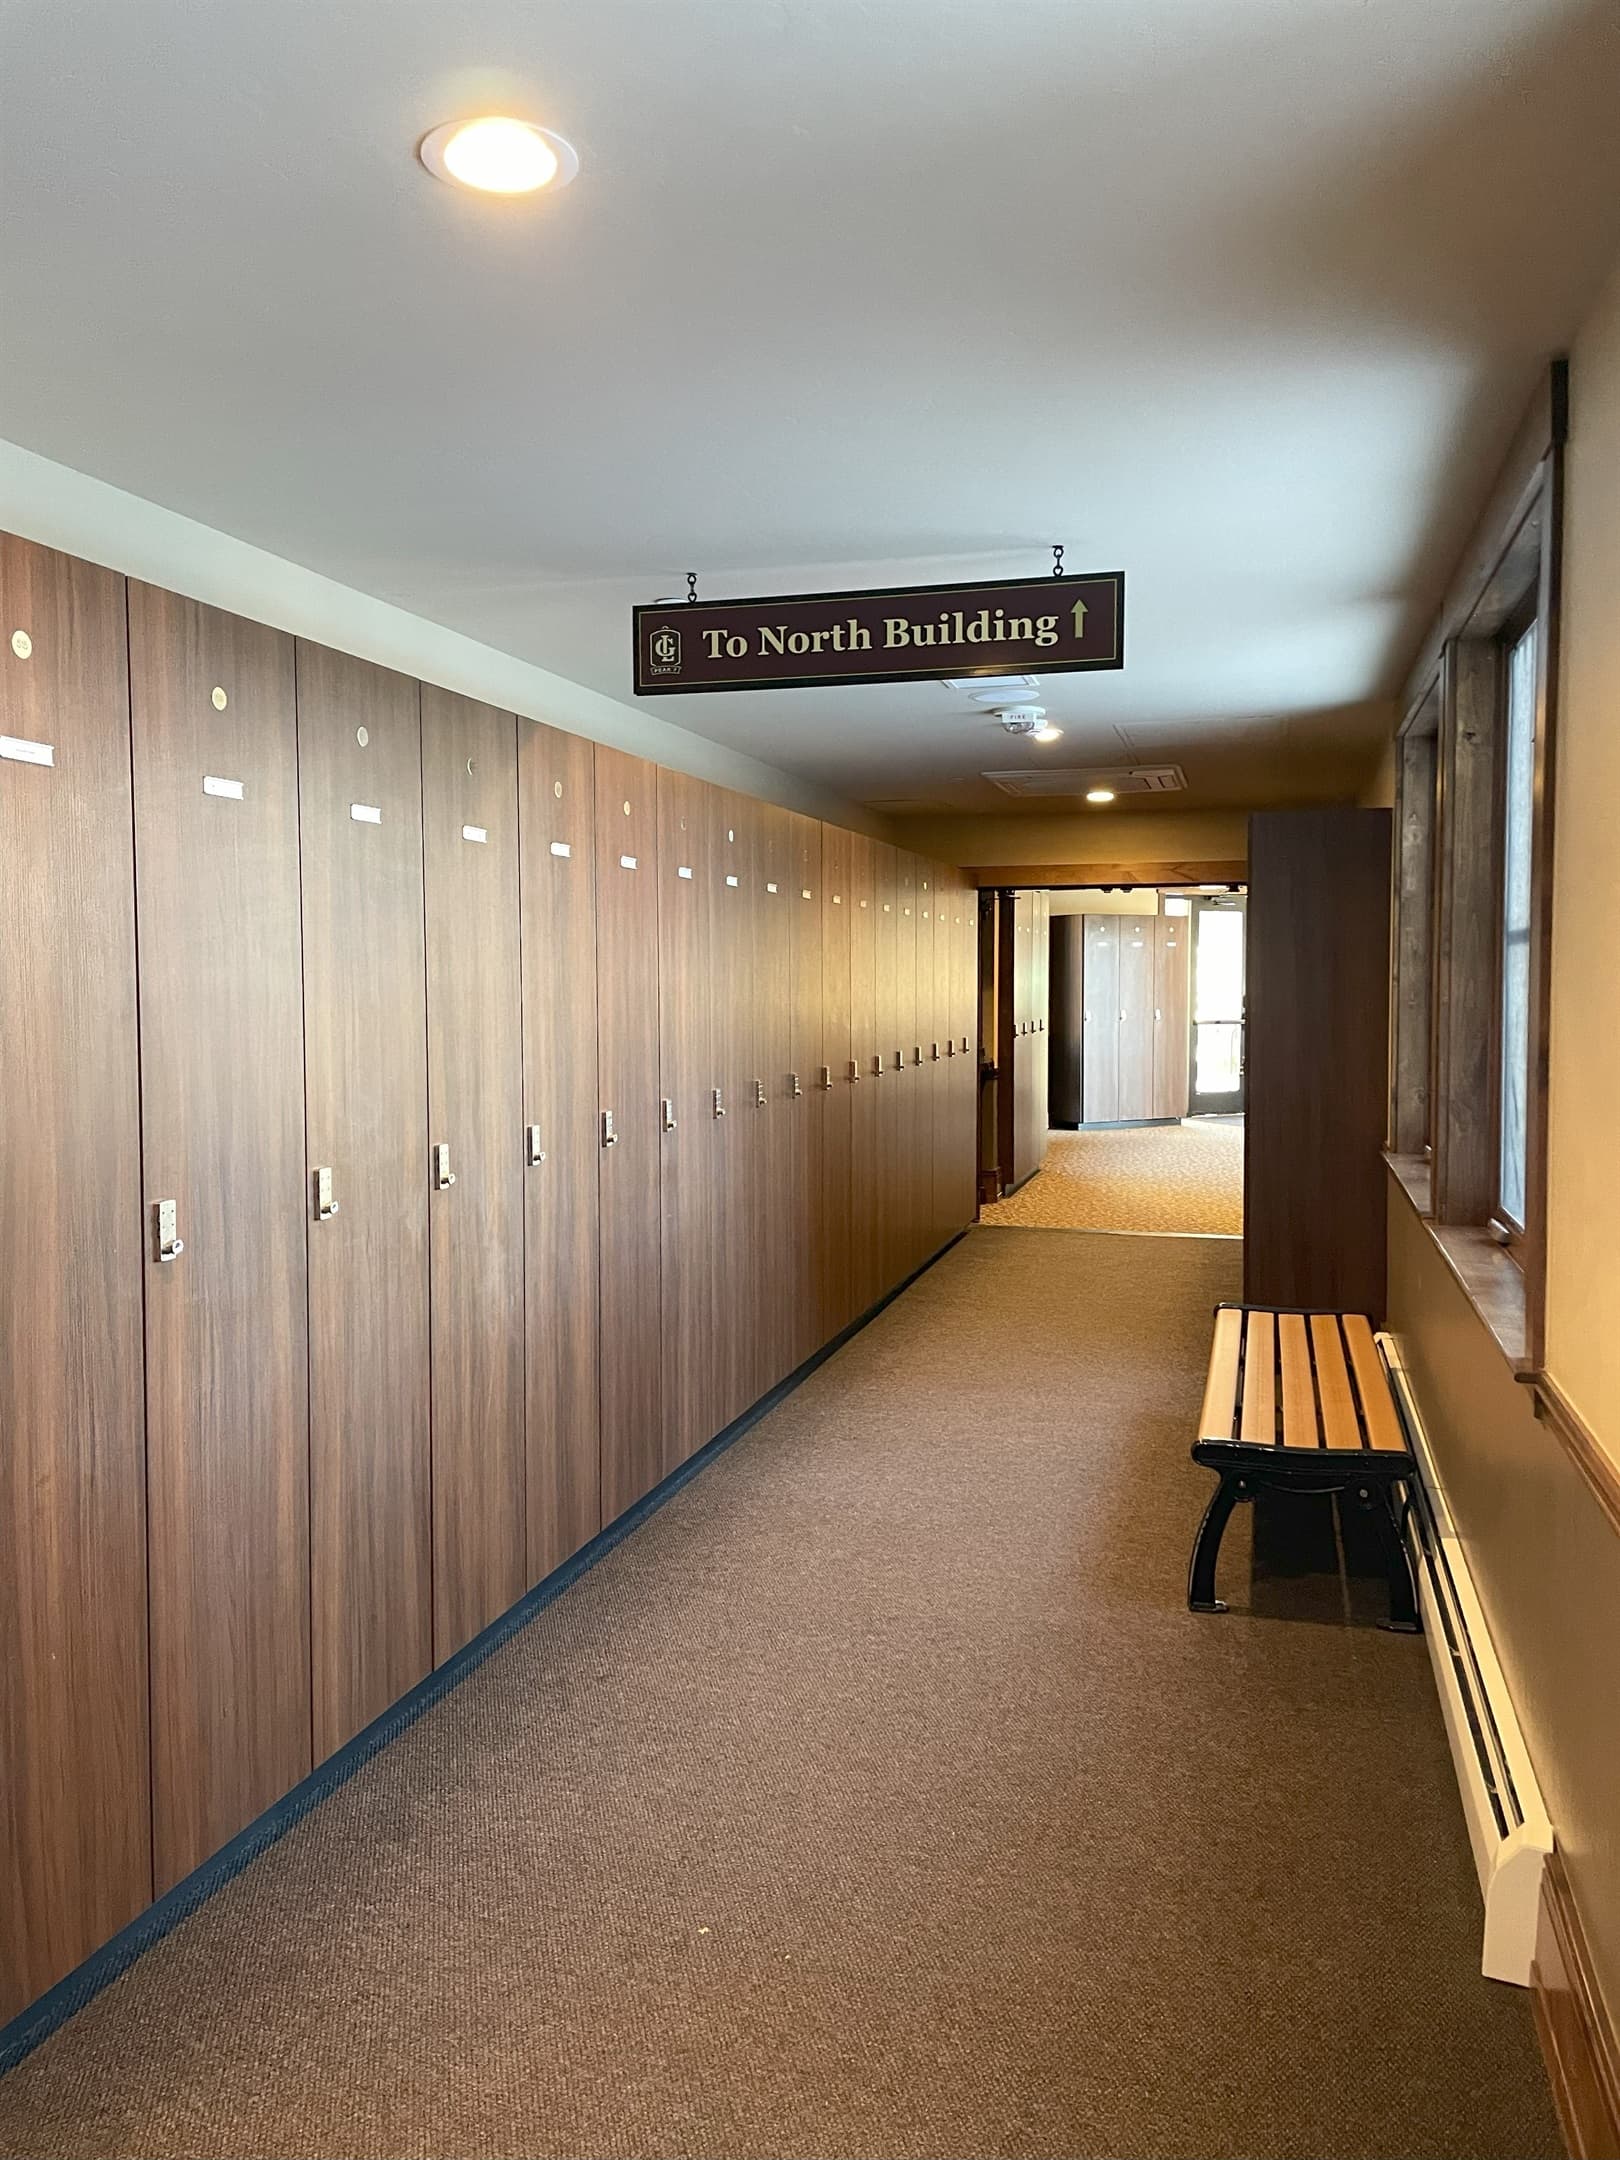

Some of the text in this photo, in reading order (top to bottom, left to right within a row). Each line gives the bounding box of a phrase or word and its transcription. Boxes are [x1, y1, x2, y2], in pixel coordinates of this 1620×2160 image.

[702, 608, 1059, 658] To North Building
